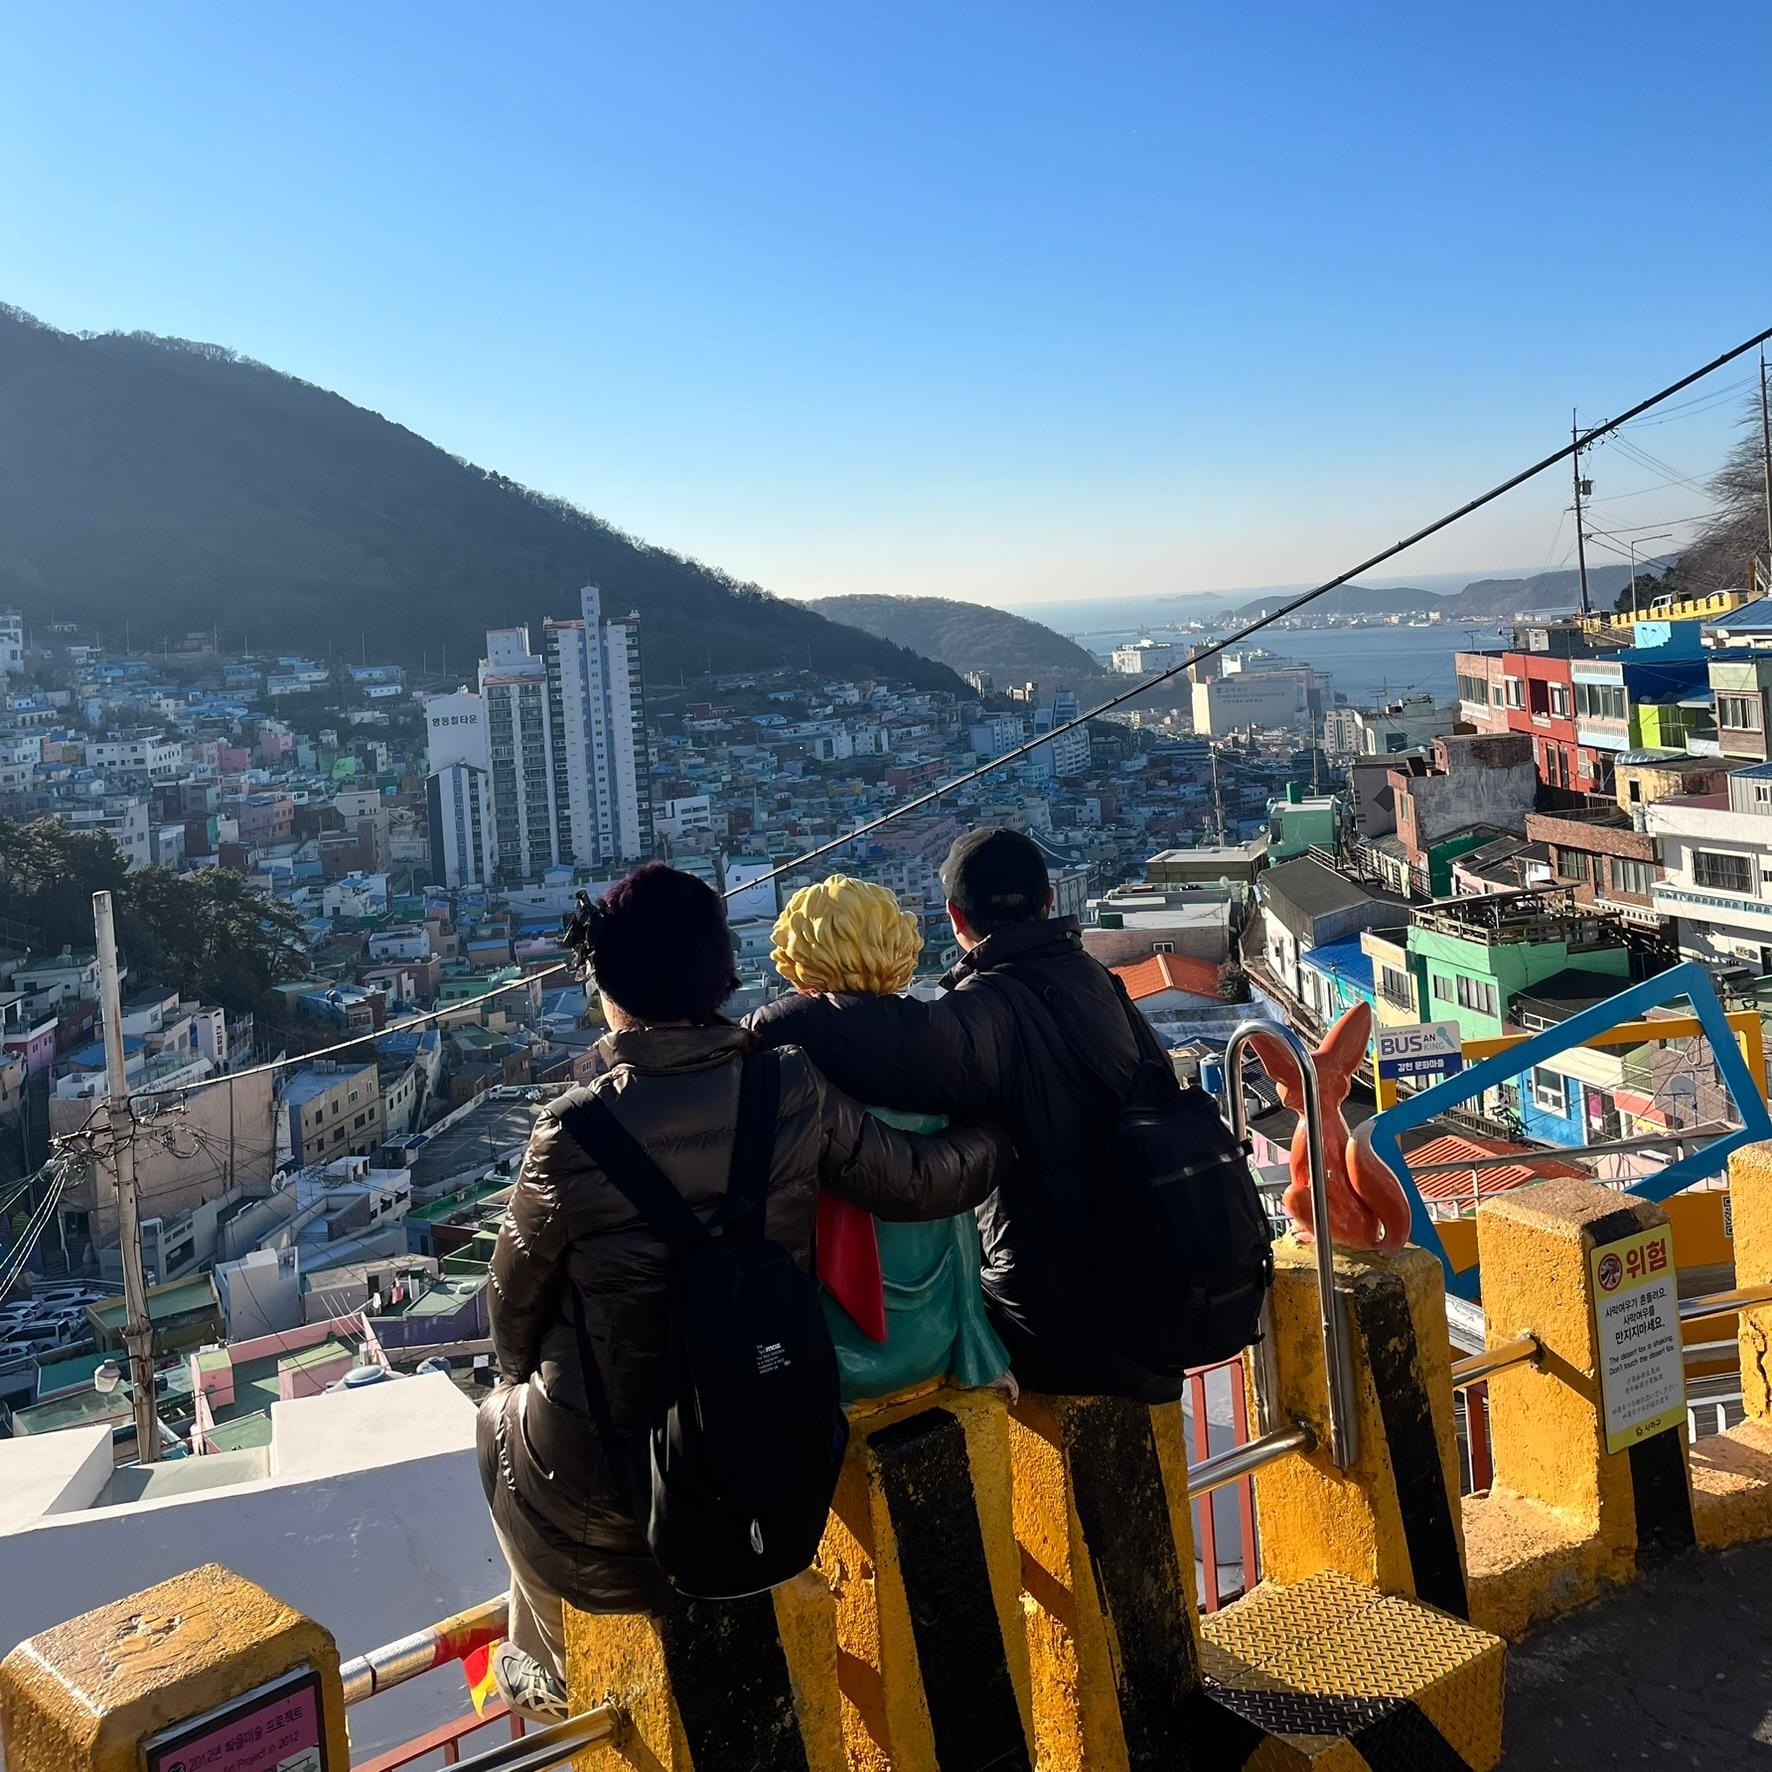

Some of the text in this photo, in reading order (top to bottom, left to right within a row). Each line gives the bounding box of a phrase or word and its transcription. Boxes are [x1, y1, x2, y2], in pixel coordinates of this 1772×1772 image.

[1397, 1059, 1445, 1072] 감천 문화마을
[1626, 1238, 1668, 1280] 위험
[1605, 1297, 1638, 1318] 사막여우가
[1623, 1304, 1656, 1325] 사막여우를
[1614, 1316, 1667, 1345] 만지지마세요.
[1609, 1356, 1620, 1365] The
[1620, 1348, 1638, 1361] desert
[1638, 1345, 1647, 1353] fox
[1609, 1364, 1623, 1376] Don't
[1623, 1359, 1639, 1370] touch
[1639, 1355, 1648, 1363] the
[1648, 1348, 1666, 1360] desert
[188, 1743, 223, 1770] 2012년
[266, 1706, 304, 1733] 프로젝트
[237, 1750, 267, 1770] Project
[268, 1744, 277, 1755] in
[278, 1731, 299, 1750] 2012
